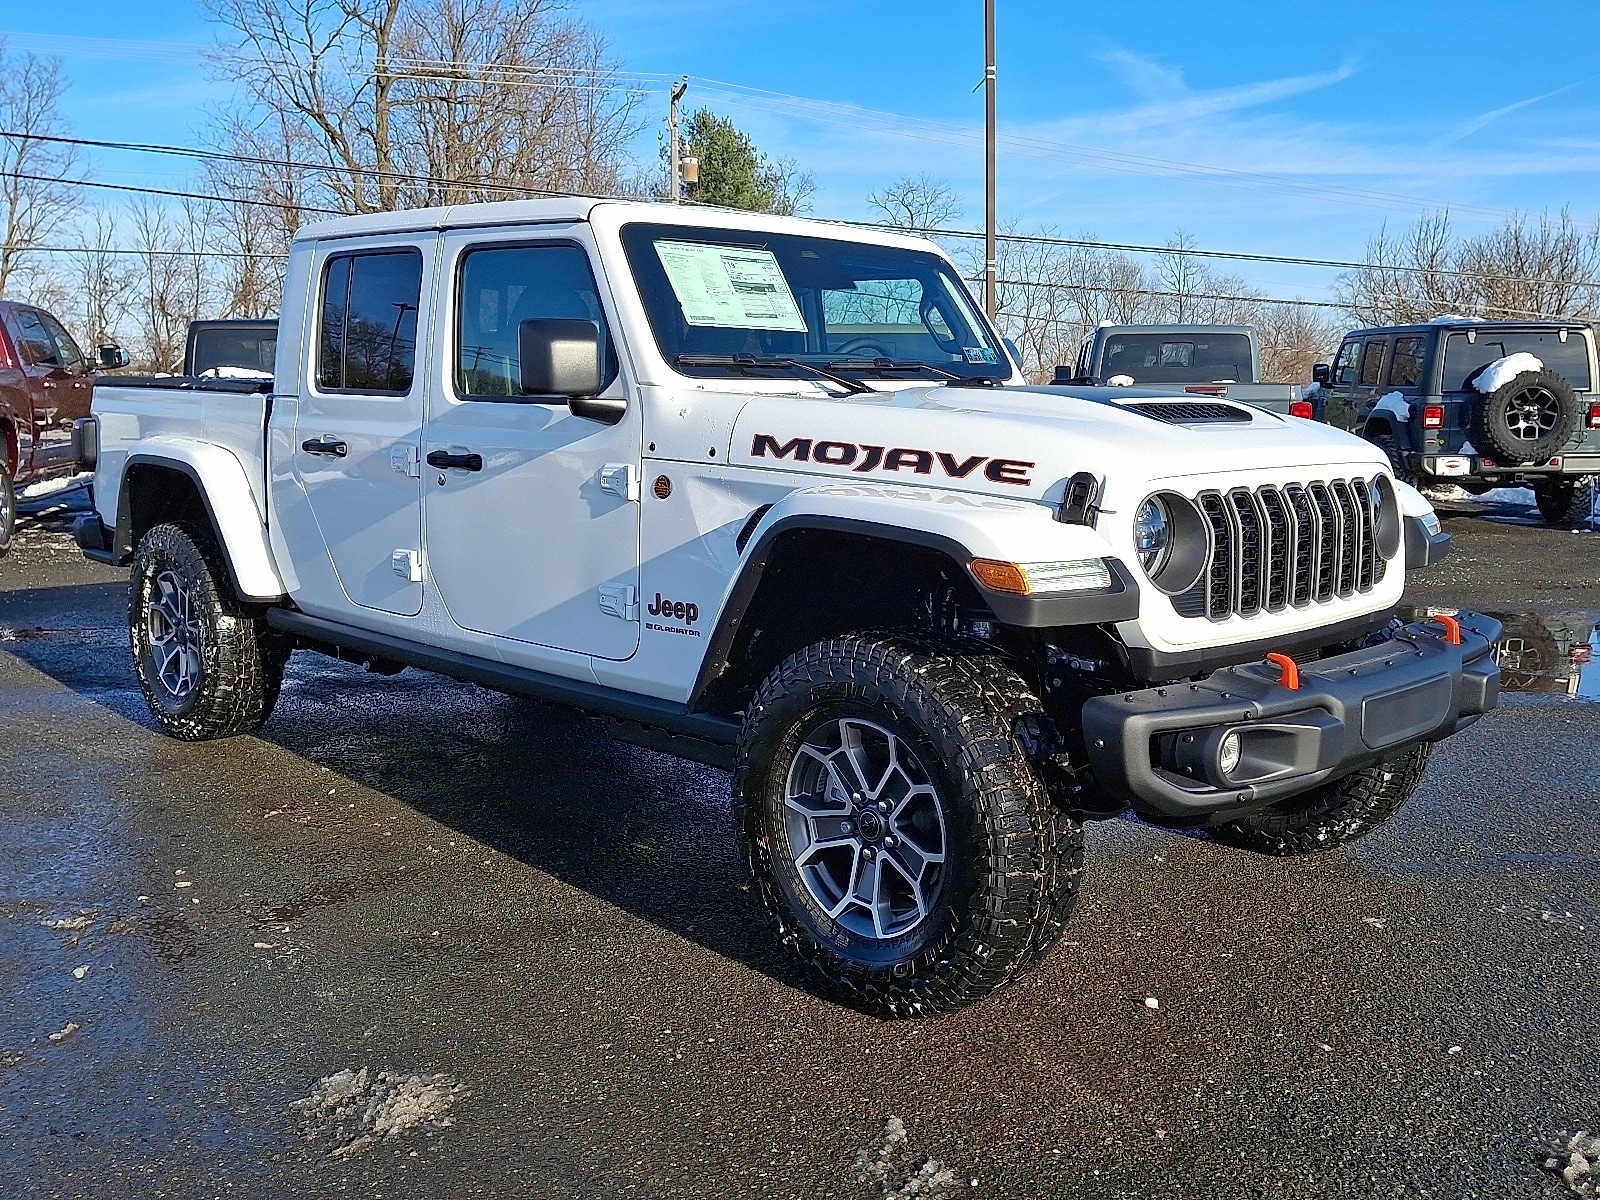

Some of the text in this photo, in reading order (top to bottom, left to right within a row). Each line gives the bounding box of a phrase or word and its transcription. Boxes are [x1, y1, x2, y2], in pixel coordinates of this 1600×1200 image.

[750, 433, 1035, 487] MOJAVE
[647, 592, 699, 626] Jeep
[653, 623, 701, 638] GLADIATOR
